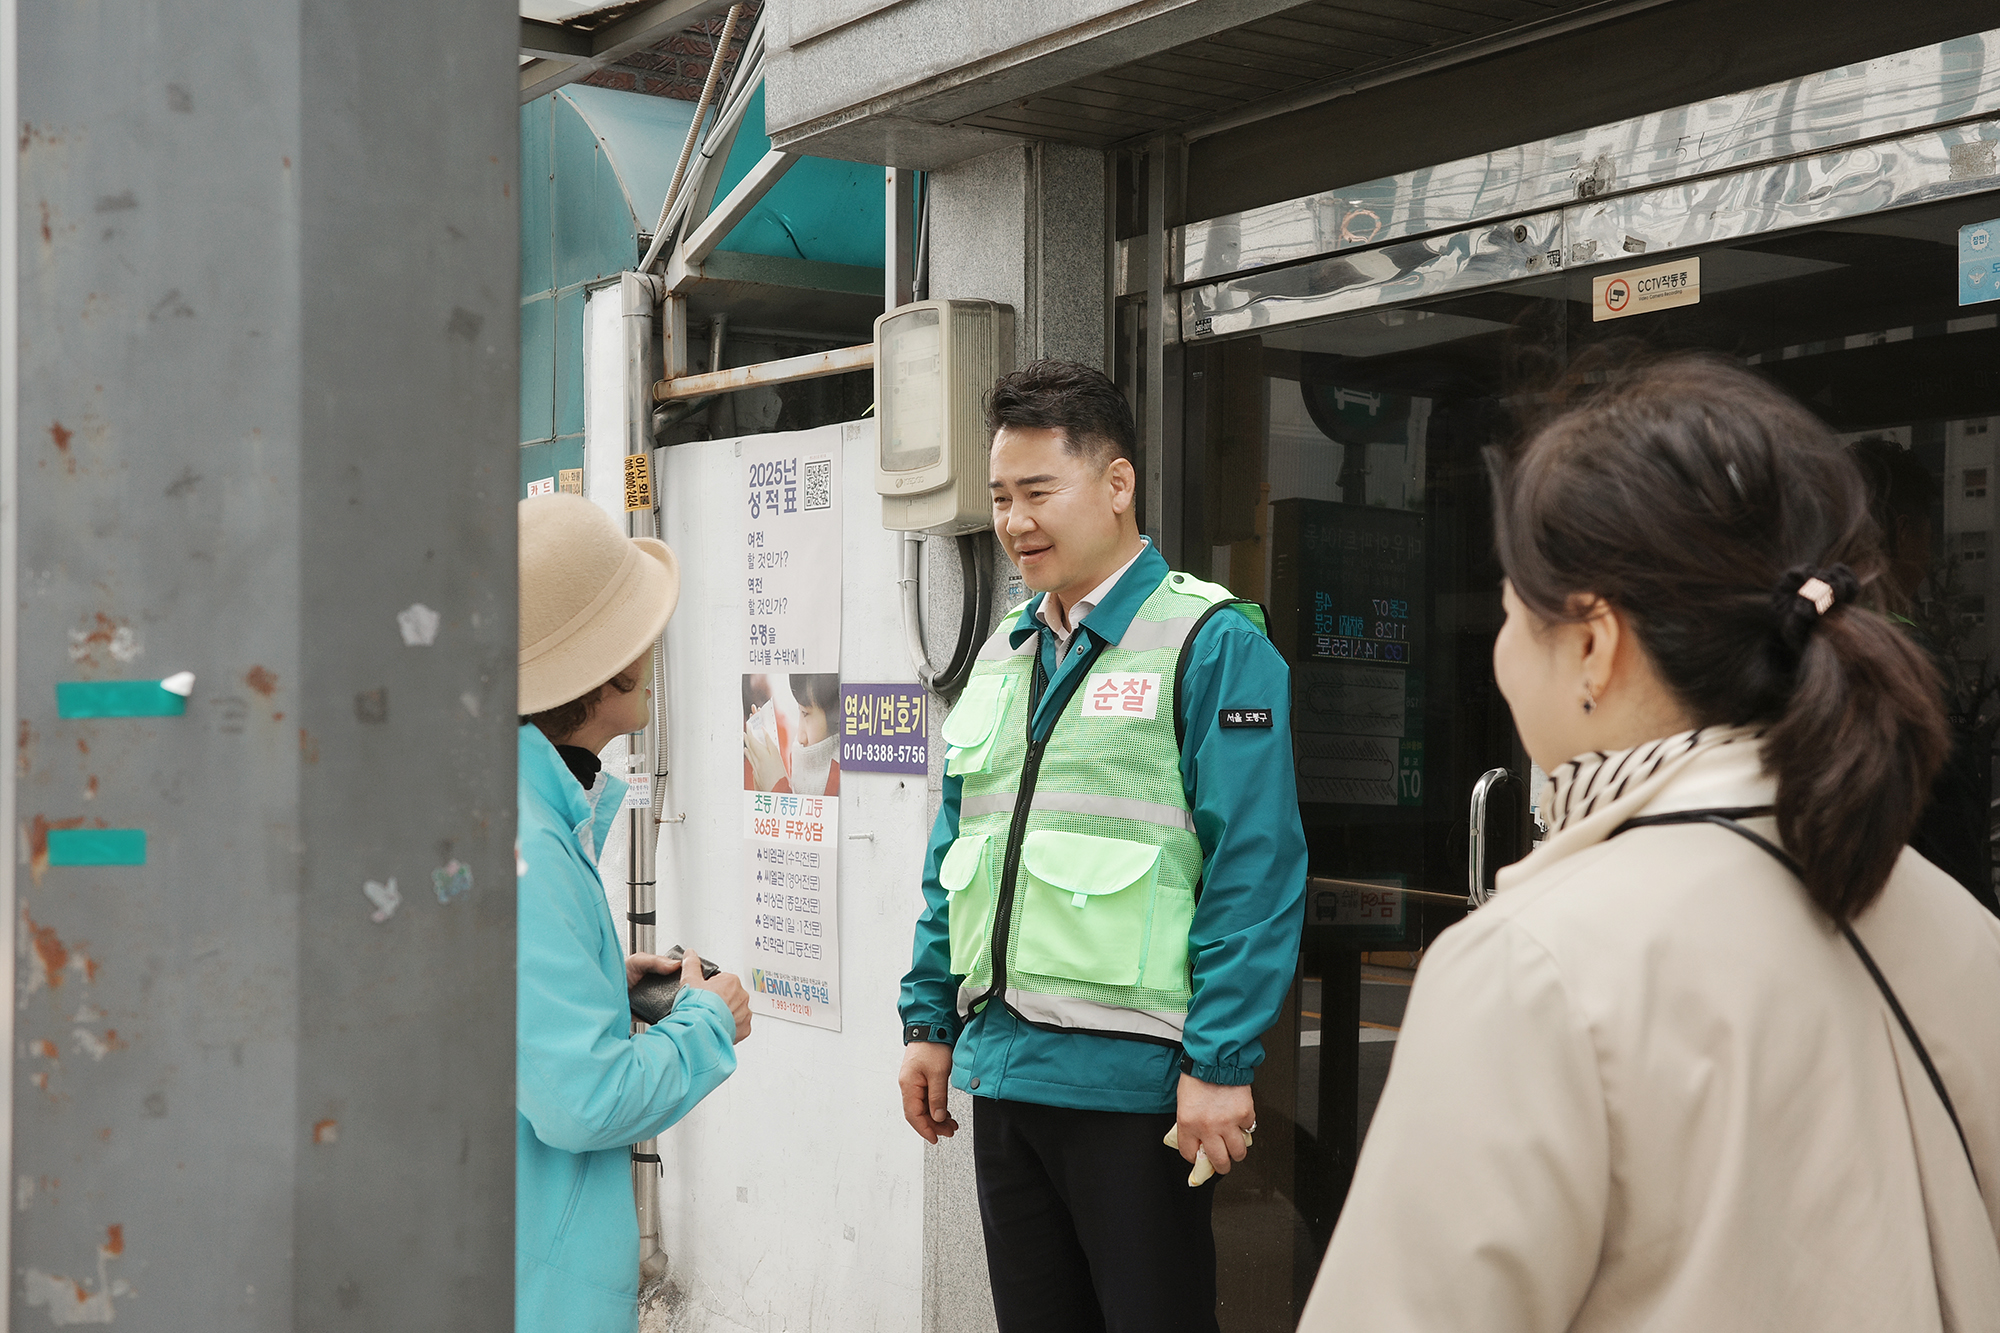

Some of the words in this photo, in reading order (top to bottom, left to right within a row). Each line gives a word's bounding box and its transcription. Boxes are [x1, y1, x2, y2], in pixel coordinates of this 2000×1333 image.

[1638, 271, 1687, 293] CCTV작동중
[749, 457, 797, 488] 2025년
[748, 486, 797, 519] 성적표
[747, 530, 764, 548] 여전
[748, 552, 755, 570] 할
[758, 550, 789, 569] 것인가?
[747, 577, 763, 594] 역전
[748, 598, 755, 615] 할
[757, 597, 788, 615] 것인가?
[749, 623, 776, 646] 유명을
[749, 648, 771, 666] 다녀볼
[1093, 678, 1152, 712] 순찰
[844, 693, 926, 738] 열쇠/번호키
[1227, 712, 1242, 723] 서울
[1245, 712, 1267, 723] 도봉구
[843, 743, 926, 764] 010-8388-5756
[780, 796, 798, 816] 중등
[754, 817, 780, 838] 365일
[785, 820, 824, 842] 무휴상담
[794, 982, 829, 1004] 유명학원
